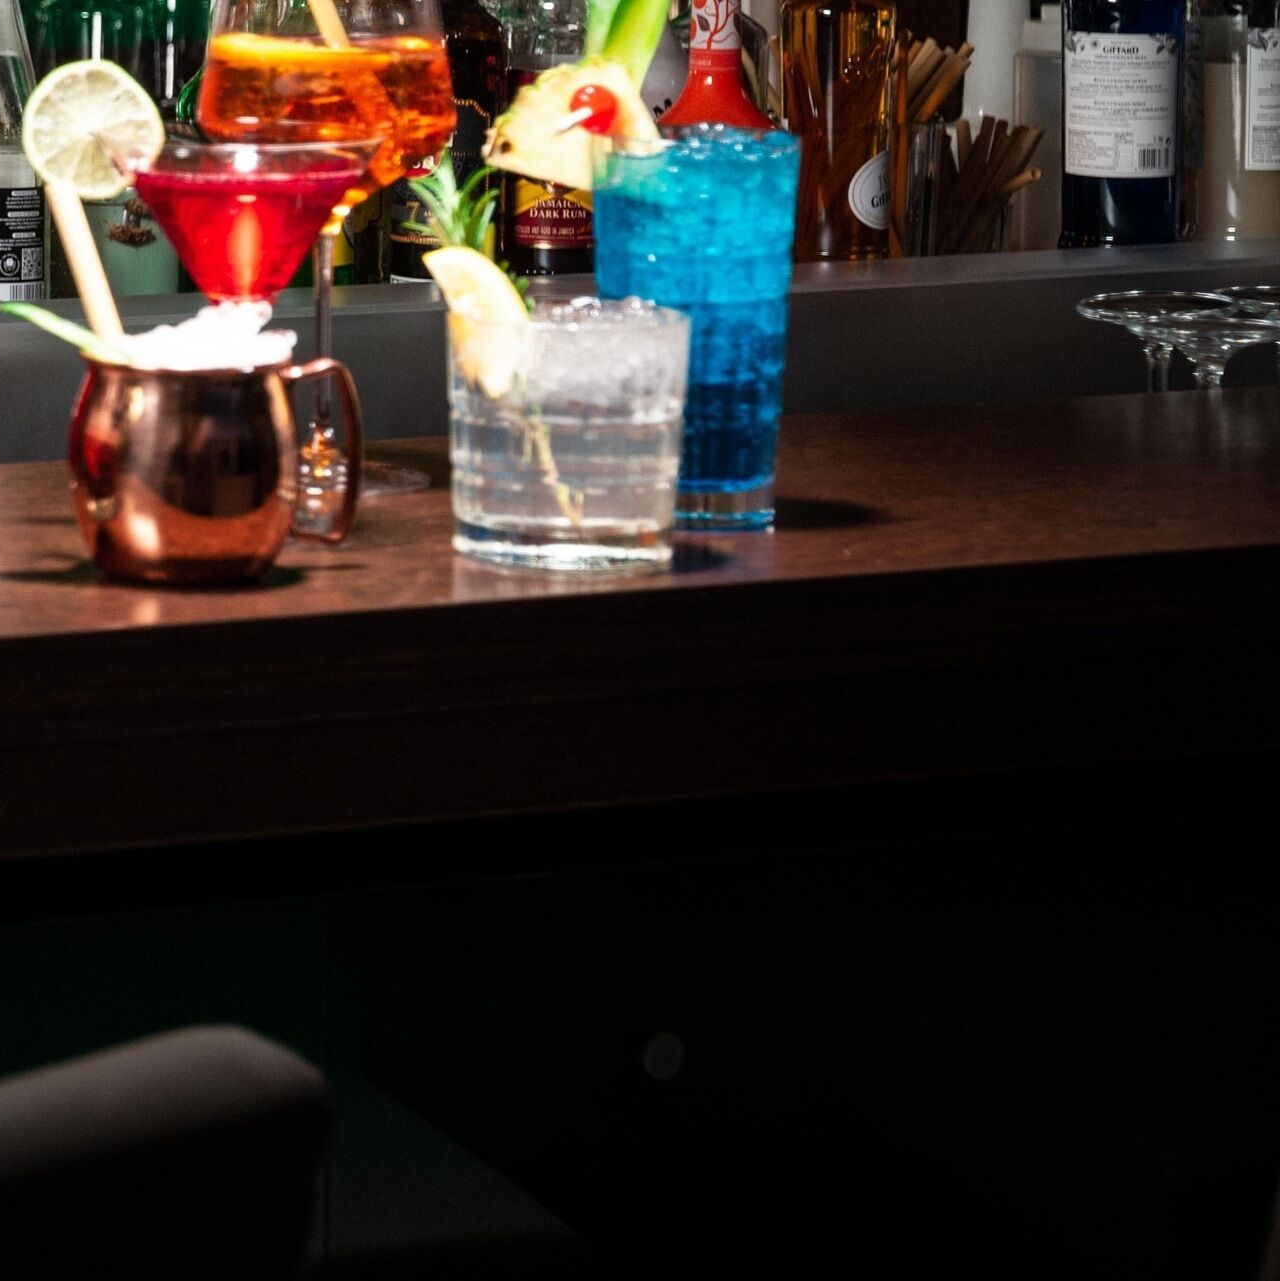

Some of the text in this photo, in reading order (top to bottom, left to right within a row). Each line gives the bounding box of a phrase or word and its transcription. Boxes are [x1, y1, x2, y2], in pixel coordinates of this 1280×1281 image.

[535, 198, 582, 208] JAMAICA
[405, 201, 421, 223] 7
[529, 207, 586, 219] DARK RUM
